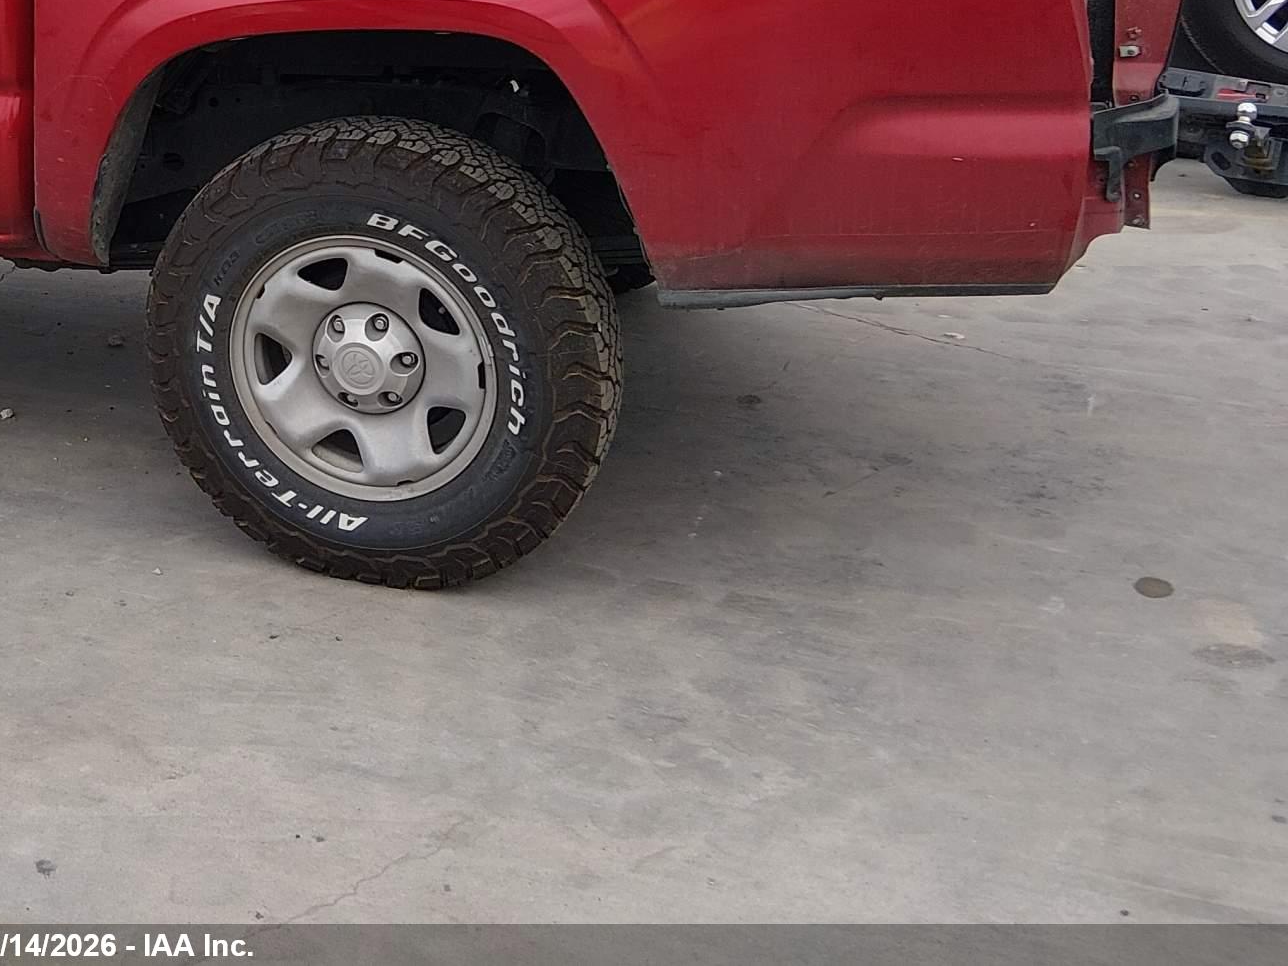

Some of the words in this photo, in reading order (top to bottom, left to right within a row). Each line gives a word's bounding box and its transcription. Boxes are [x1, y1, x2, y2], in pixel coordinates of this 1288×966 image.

[195, 293, 222, 354] T/A
[366, 212, 528, 436] BFGoodrich
[198, 364, 370, 533] All-Terrain
